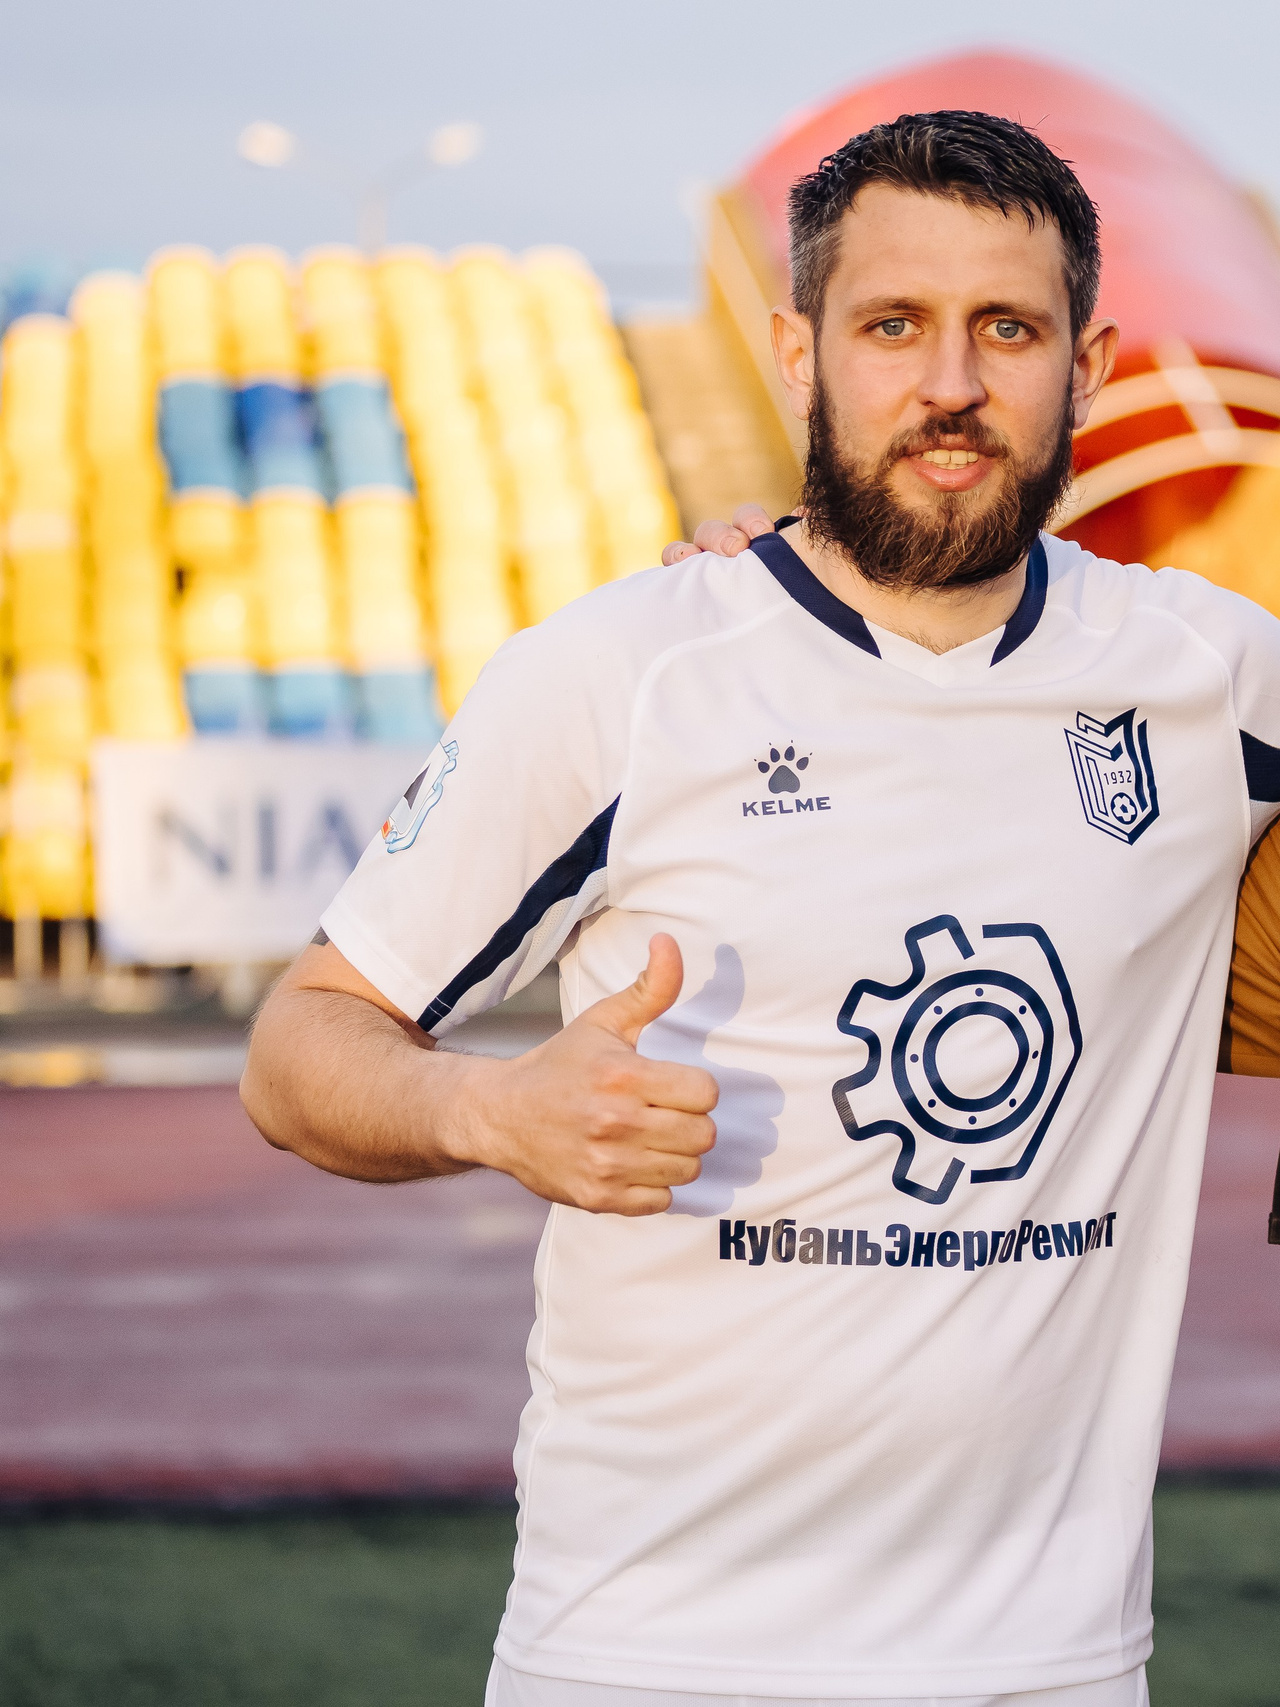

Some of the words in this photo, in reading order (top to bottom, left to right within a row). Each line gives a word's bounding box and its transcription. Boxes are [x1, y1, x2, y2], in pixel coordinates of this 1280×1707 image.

[1103, 770, 1132, 785] 1932
[742, 796, 831, 817] KELME
[718, 1211, 1118, 1272] КубаньЭнергоРемонт
